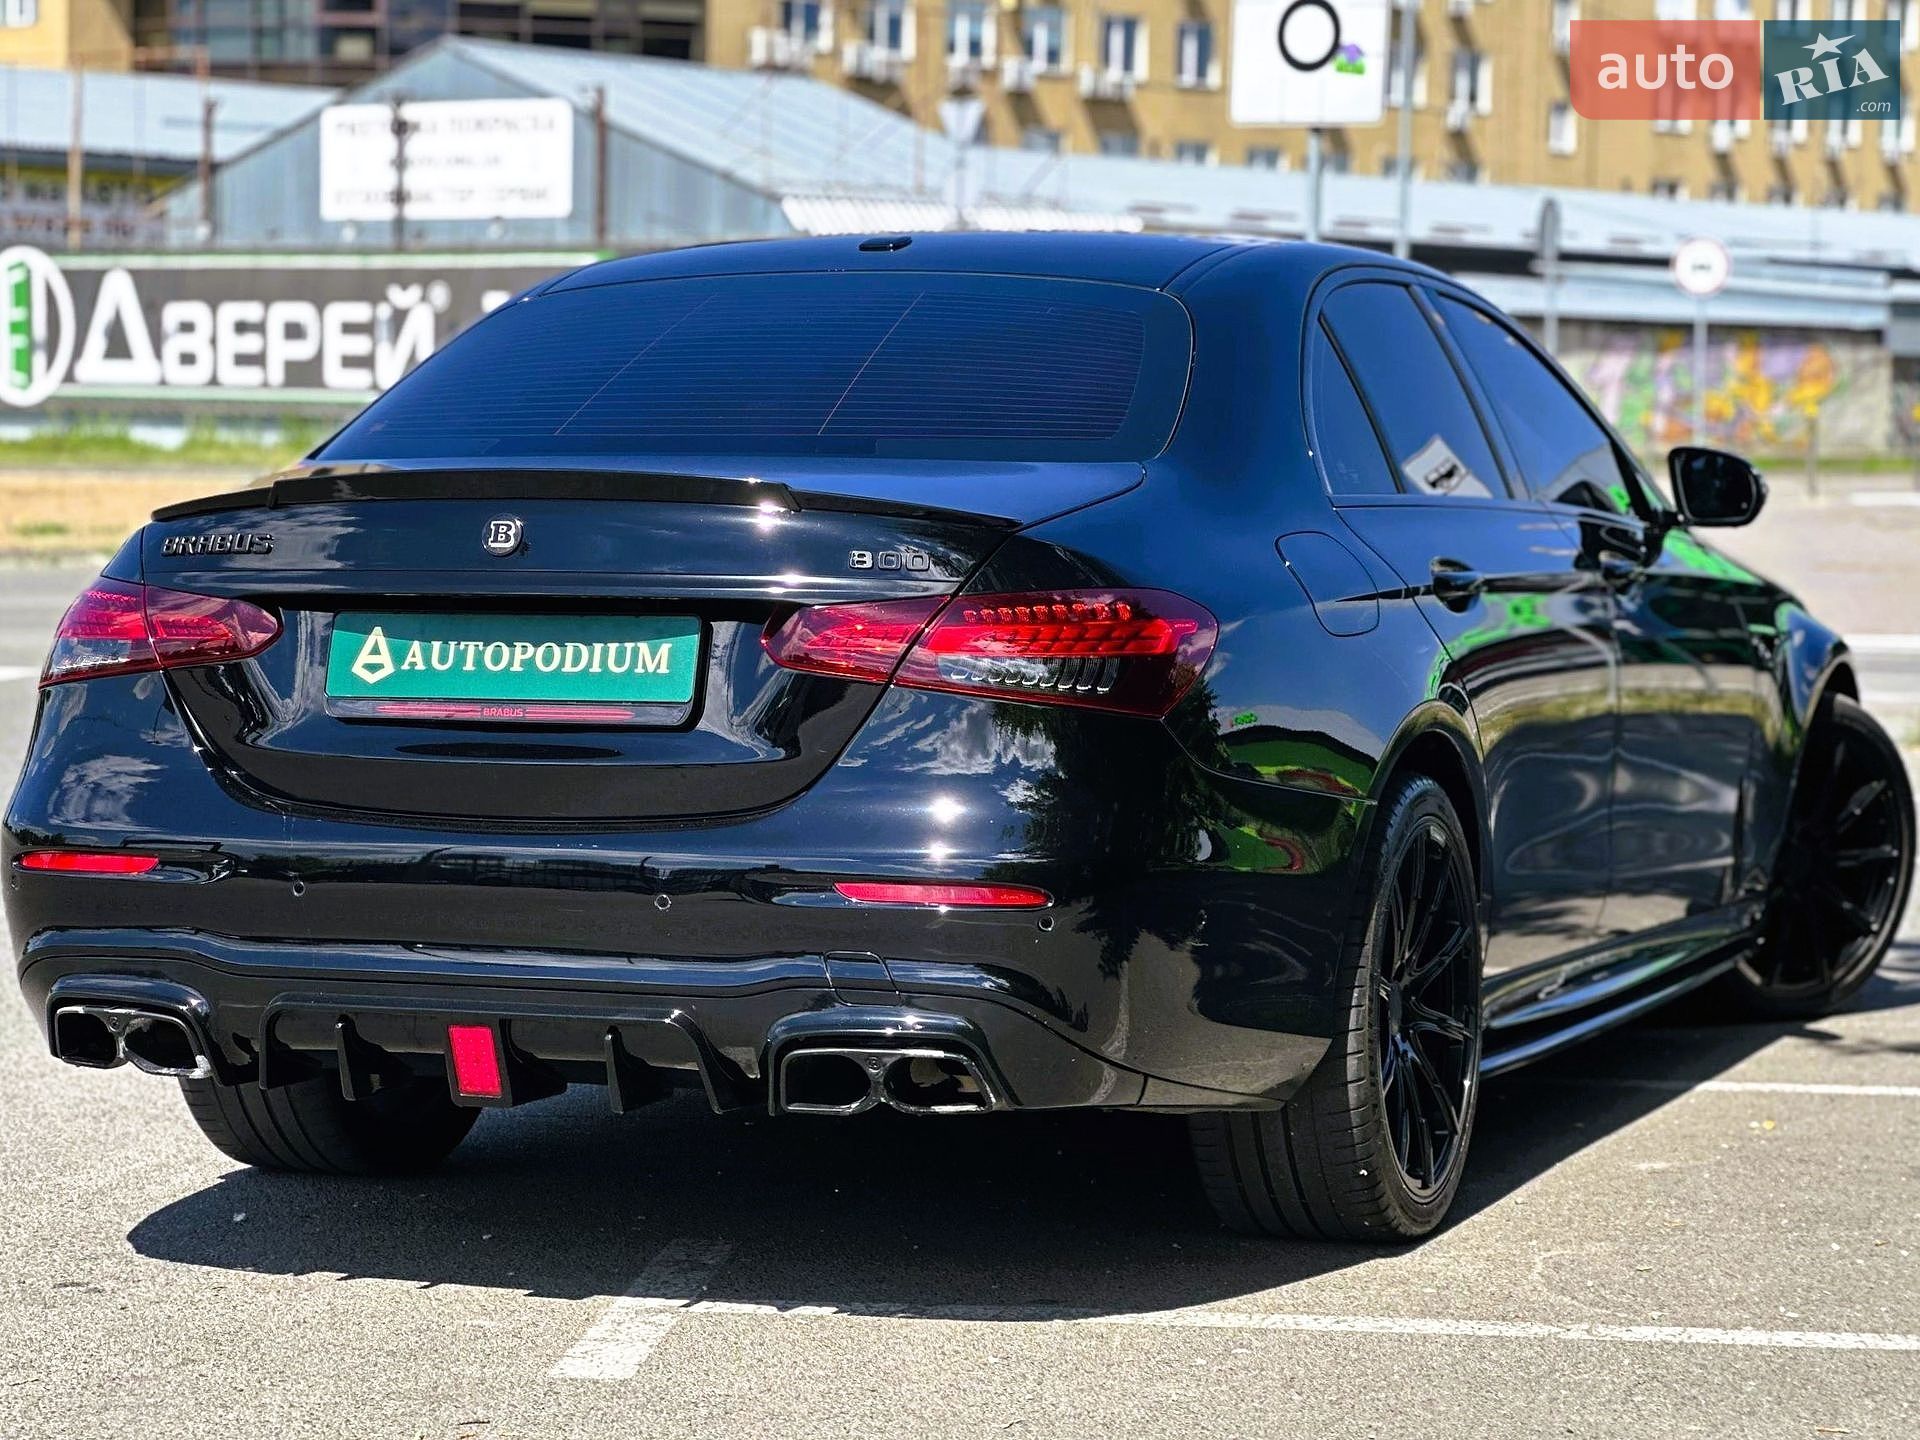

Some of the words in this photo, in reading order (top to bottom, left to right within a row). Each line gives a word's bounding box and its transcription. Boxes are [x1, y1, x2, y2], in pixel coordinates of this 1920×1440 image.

[488, 520, 516, 548] B
[849, 550, 931, 572] 800
[401, 640, 673, 674] AUTOPODIUM
[483, 707, 524, 717] BRABUS
